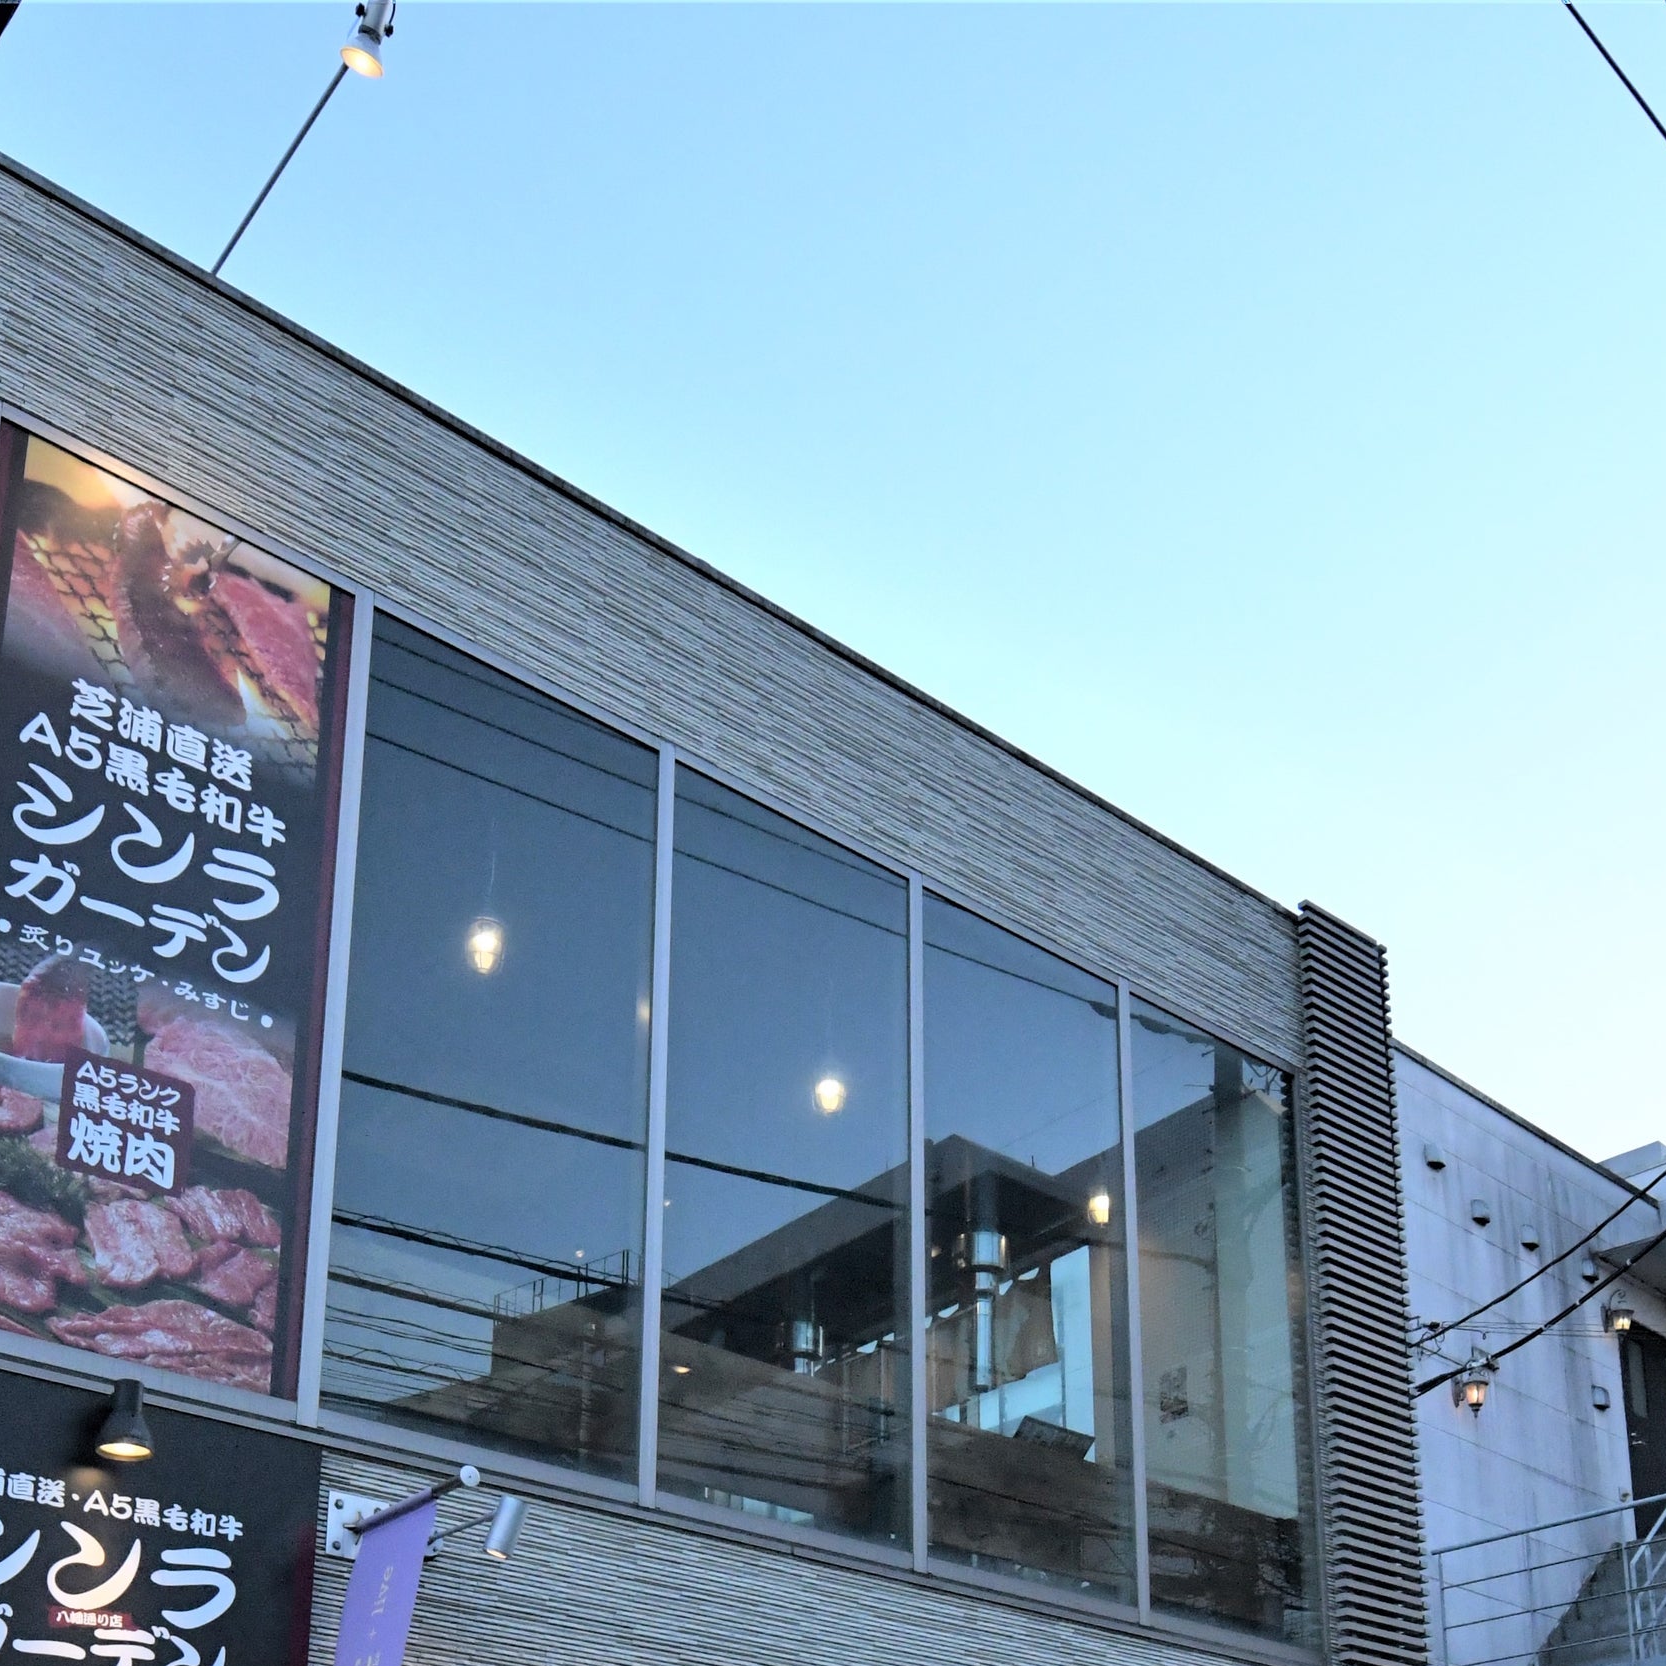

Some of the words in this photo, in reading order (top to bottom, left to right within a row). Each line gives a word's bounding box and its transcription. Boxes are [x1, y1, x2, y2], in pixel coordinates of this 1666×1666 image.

[19, 712, 287, 848] A5黒毛和牛
[70, 677, 253, 792] 芝浦直送
[12, 763, 279, 921] シンラ
[4, 854, 270, 983] ガーデン
[73, 1082, 181, 1137] 黒毛和牛
[76, 1060, 181, 1107] A5ランク
[67, 1112, 175, 1190] 焼肉
